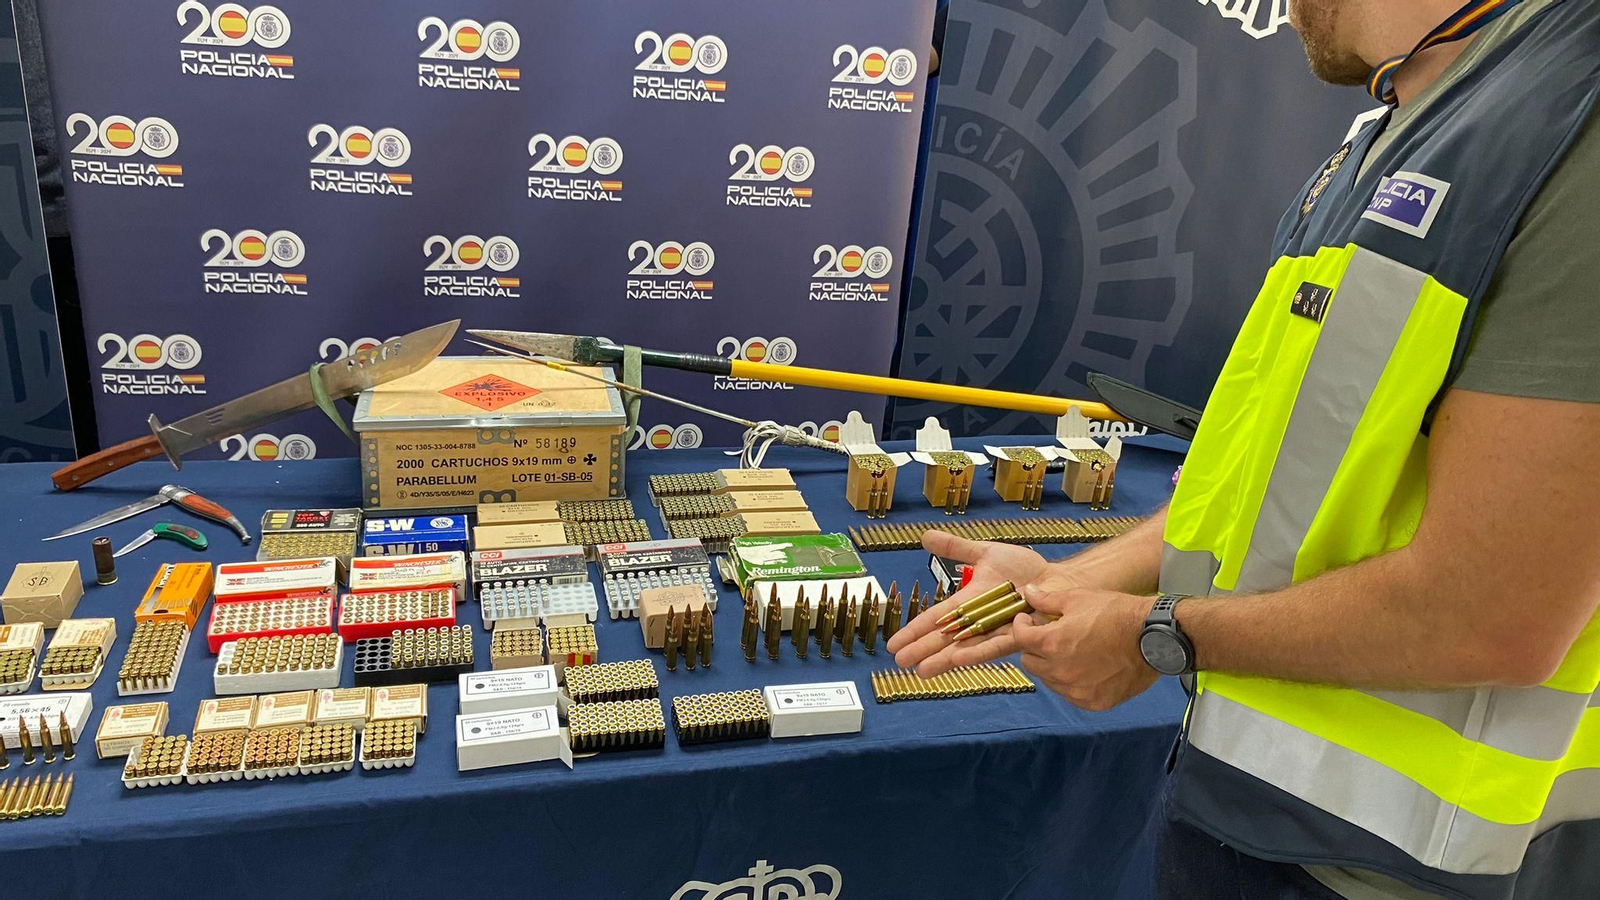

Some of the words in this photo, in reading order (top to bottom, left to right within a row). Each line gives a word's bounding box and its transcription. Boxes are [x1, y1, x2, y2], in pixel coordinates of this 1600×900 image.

[177, 0, 291, 48] 200
[418, 16, 520, 62] 200
[180, 50, 270, 66] POLICIA
[634, 31, 728, 74] 200
[182, 63, 295, 79] NACIONAL
[418, 64, 500, 79] POLICIA
[831, 44, 917, 86] 200
[418, 76, 520, 91] NACIONAL
[633, 76, 708, 90] POLICIA
[633, 87, 726, 102] NACIONAL
[829, 87, 898, 101] POLICIA
[828, 99, 913, 113] NACIONAL
[66, 113, 179, 158] 200
[308, 124, 411, 168] 200
[528, 133, 623, 174] 200
[71, 160, 160, 175] POLICIA
[729, 143, 815, 183] 200
[73, 172, 184, 188] NACIONAL
[310, 169, 392, 184] POLICIA
[528, 177, 604, 190] POLICIA
[310, 180, 413, 195] NACIONAL
[727, 185, 795, 198] POLICIA
[528, 188, 622, 202] NACIONAL
[726, 196, 812, 208] NACIONAL
[201, 228, 306, 268] 200
[423, 235, 519, 272] 200
[627, 240, 715, 276] 200
[812, 244, 893, 278] 200
[204, 271, 287, 283] POLICIA
[424, 276, 501, 287] POLICIA
[204, 283, 308, 295] NACIONAL
[424, 286, 520, 298] NACIONAL
[626, 280, 696, 290] POLICIA
[810, 282, 874, 292] POLICIA
[626, 290, 713, 300] NACIONAL
[809, 292, 889, 302] NACIONAL
[97, 333, 203, 370] 200
[102, 374, 184, 385] POLICIA
[714, 382, 794, 390] NACIONAL
[103, 384, 207, 395] NACIONAL
[396, 459, 425, 469] 2000
[431, 457, 509, 468] CARTUCHOS
[512, 456, 539, 466] 9x19
[396, 475, 477, 486] PARABELLUM
[512, 473, 542, 482] LOTE
[544, 472, 593, 483] 01-SB-05
[425, 543, 439, 552] 50
[264, 564, 314, 572] WINCHESTER
[608, 555, 672, 567] BLAZER
[480, 563, 548, 576] BLAZER
[751, 565, 821, 575] Remington
